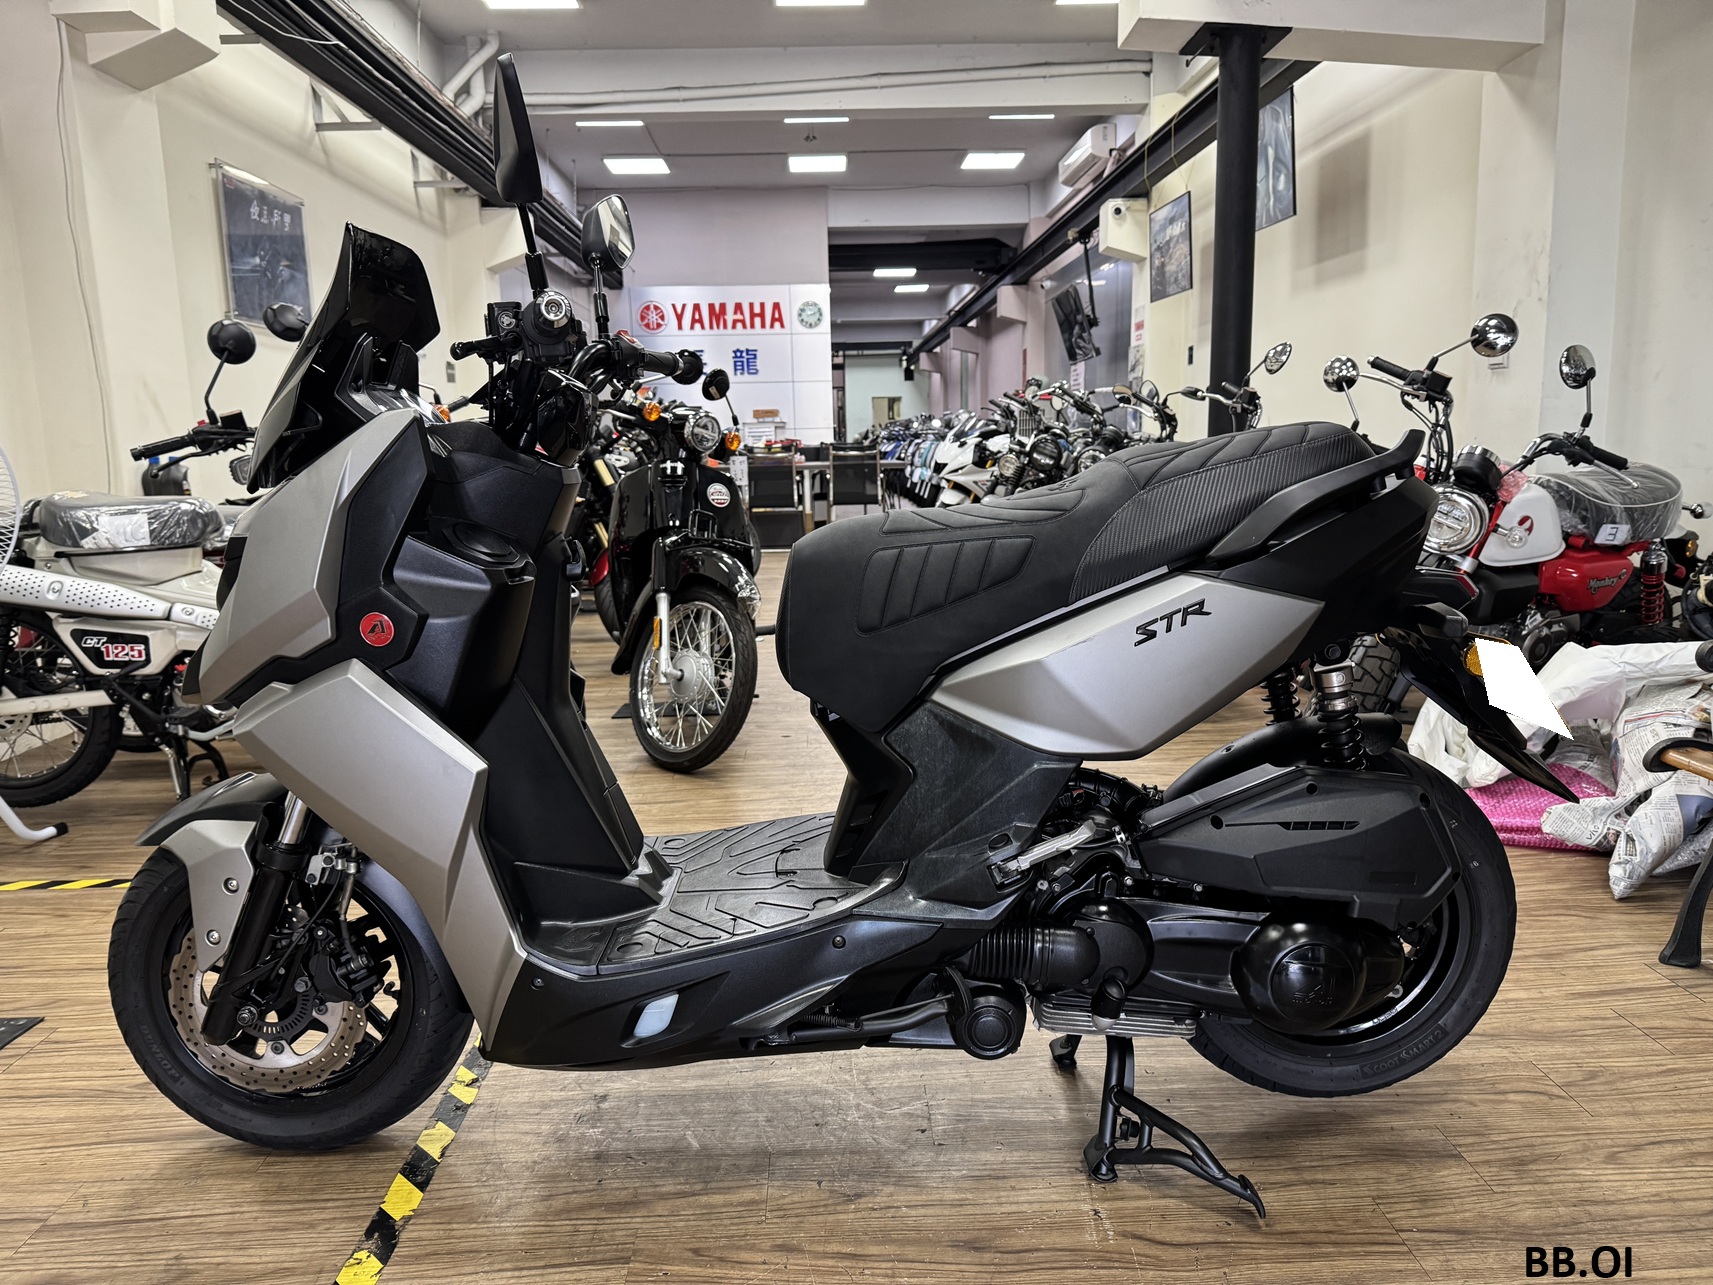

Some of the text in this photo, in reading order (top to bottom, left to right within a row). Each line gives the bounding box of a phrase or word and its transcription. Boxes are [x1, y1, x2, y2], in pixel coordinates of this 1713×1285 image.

[671, 302, 785, 331] YAMAHA
[732, 348, 759, 376] 龍
[1587, 576, 1619, 594] Monkey
[1134, 598, 1212, 647] STR
[81, 636, 107, 648] CT
[100, 644, 146, 661] 125
[140, 1024, 180, 1083] DUNLOP
